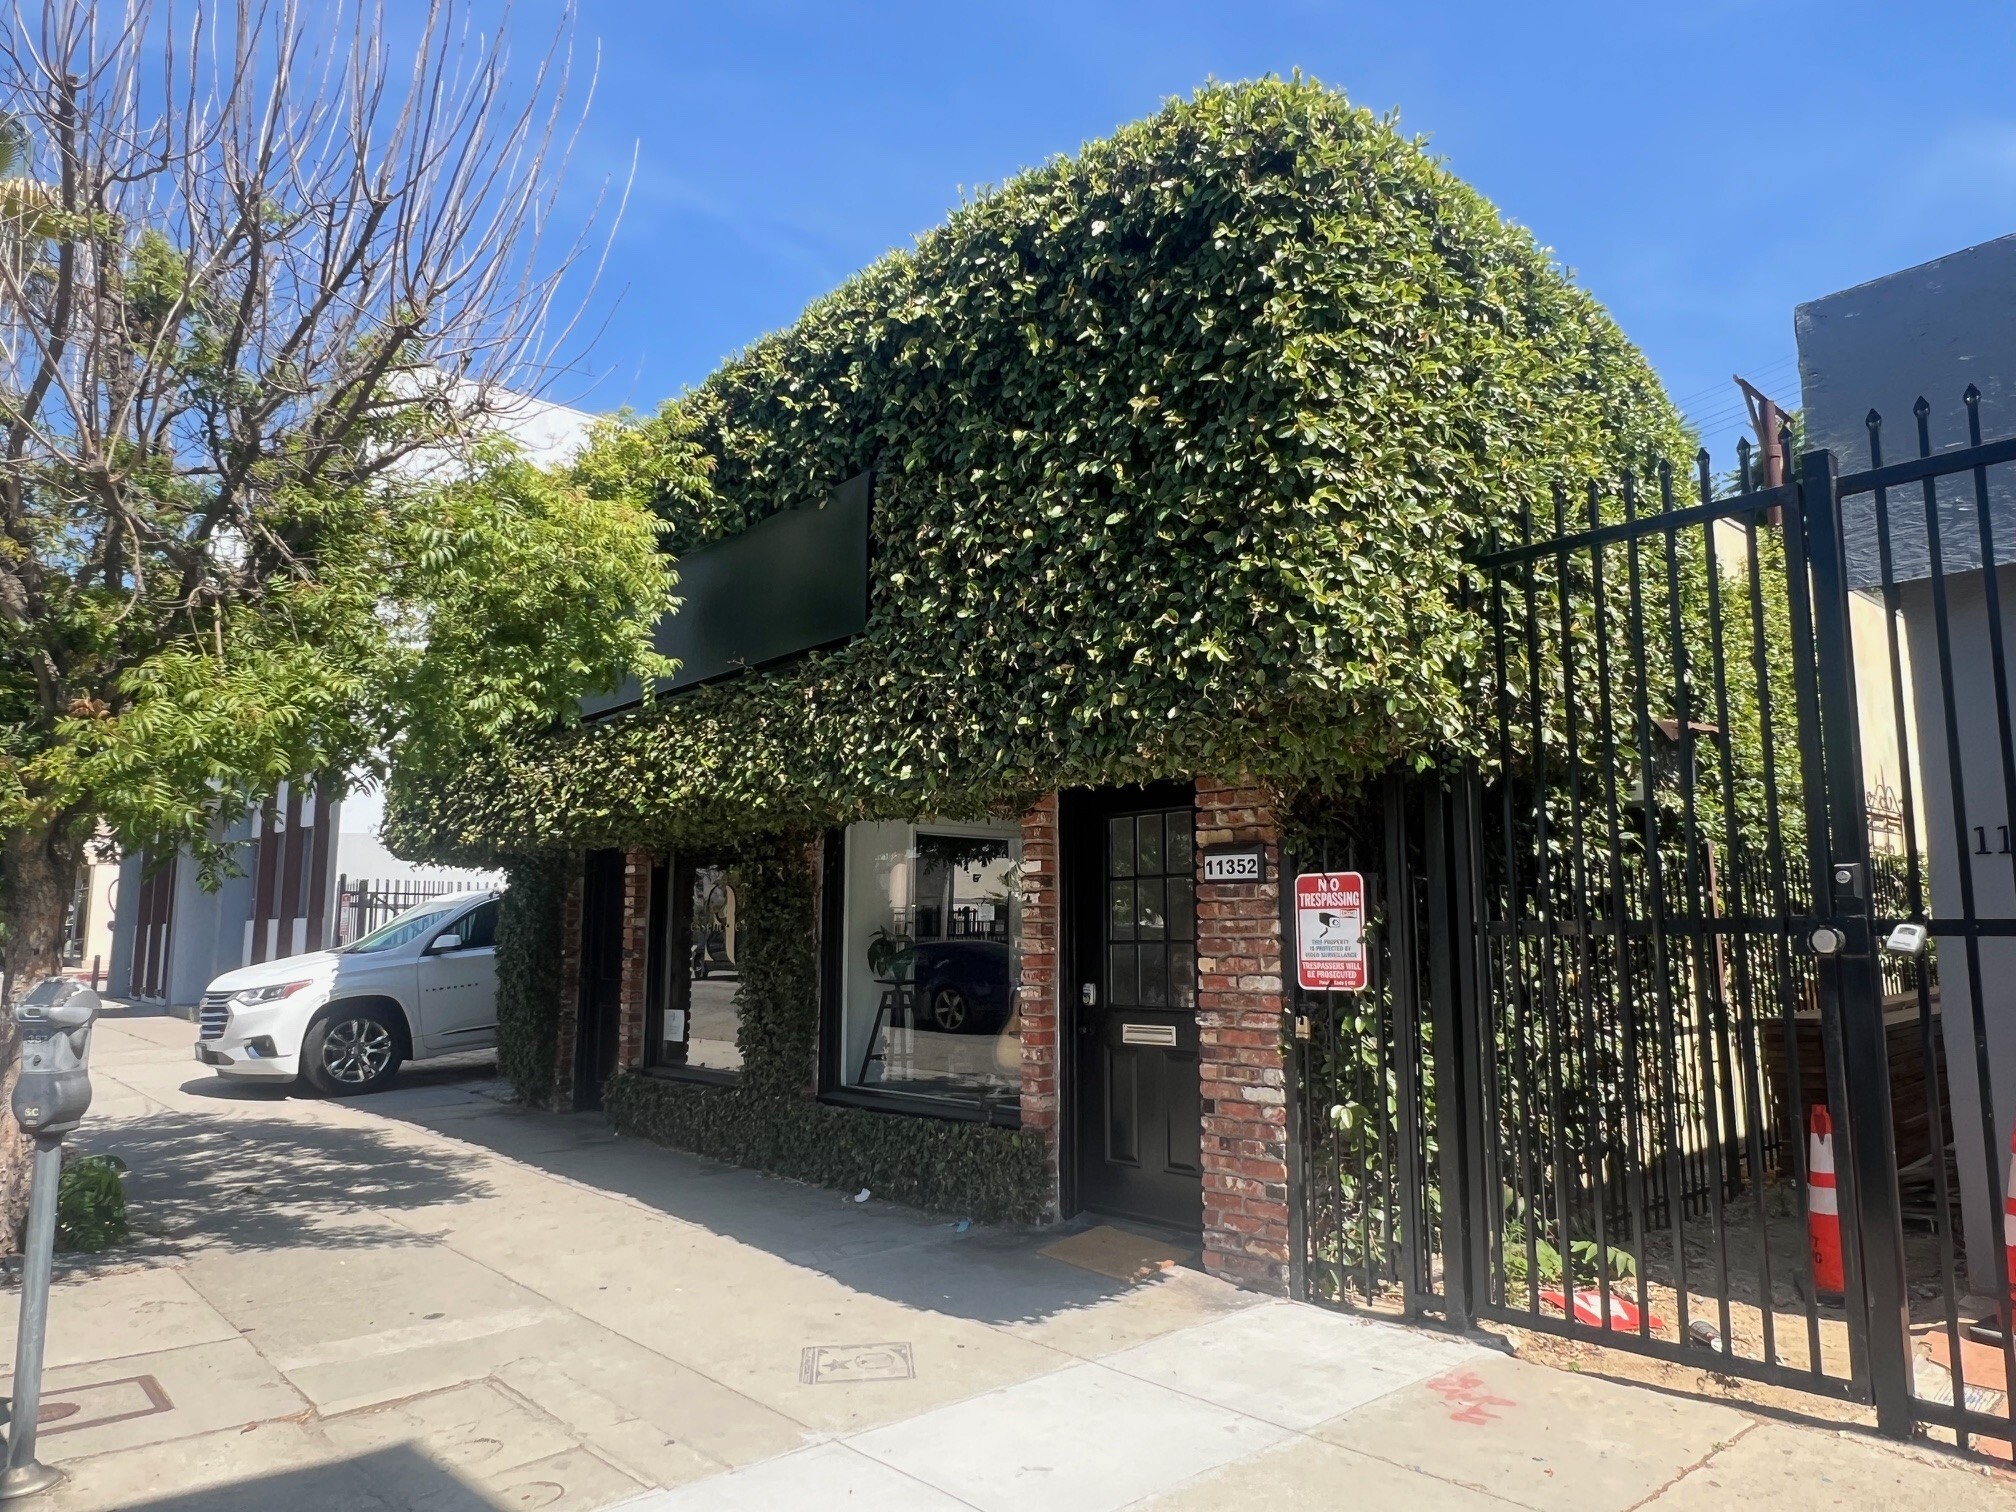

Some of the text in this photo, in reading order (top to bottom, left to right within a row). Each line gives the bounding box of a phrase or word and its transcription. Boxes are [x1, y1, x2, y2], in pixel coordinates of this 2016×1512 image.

[1206, 858, 1257, 875] 11352
[1317, 878, 1339, 892] NO
[1299, 891, 1360, 907] TRESPASSING
[1302, 961, 1361, 971] TRESPASSERS WILL
[1307, 970, 1357, 979] BE PROSECUTED
